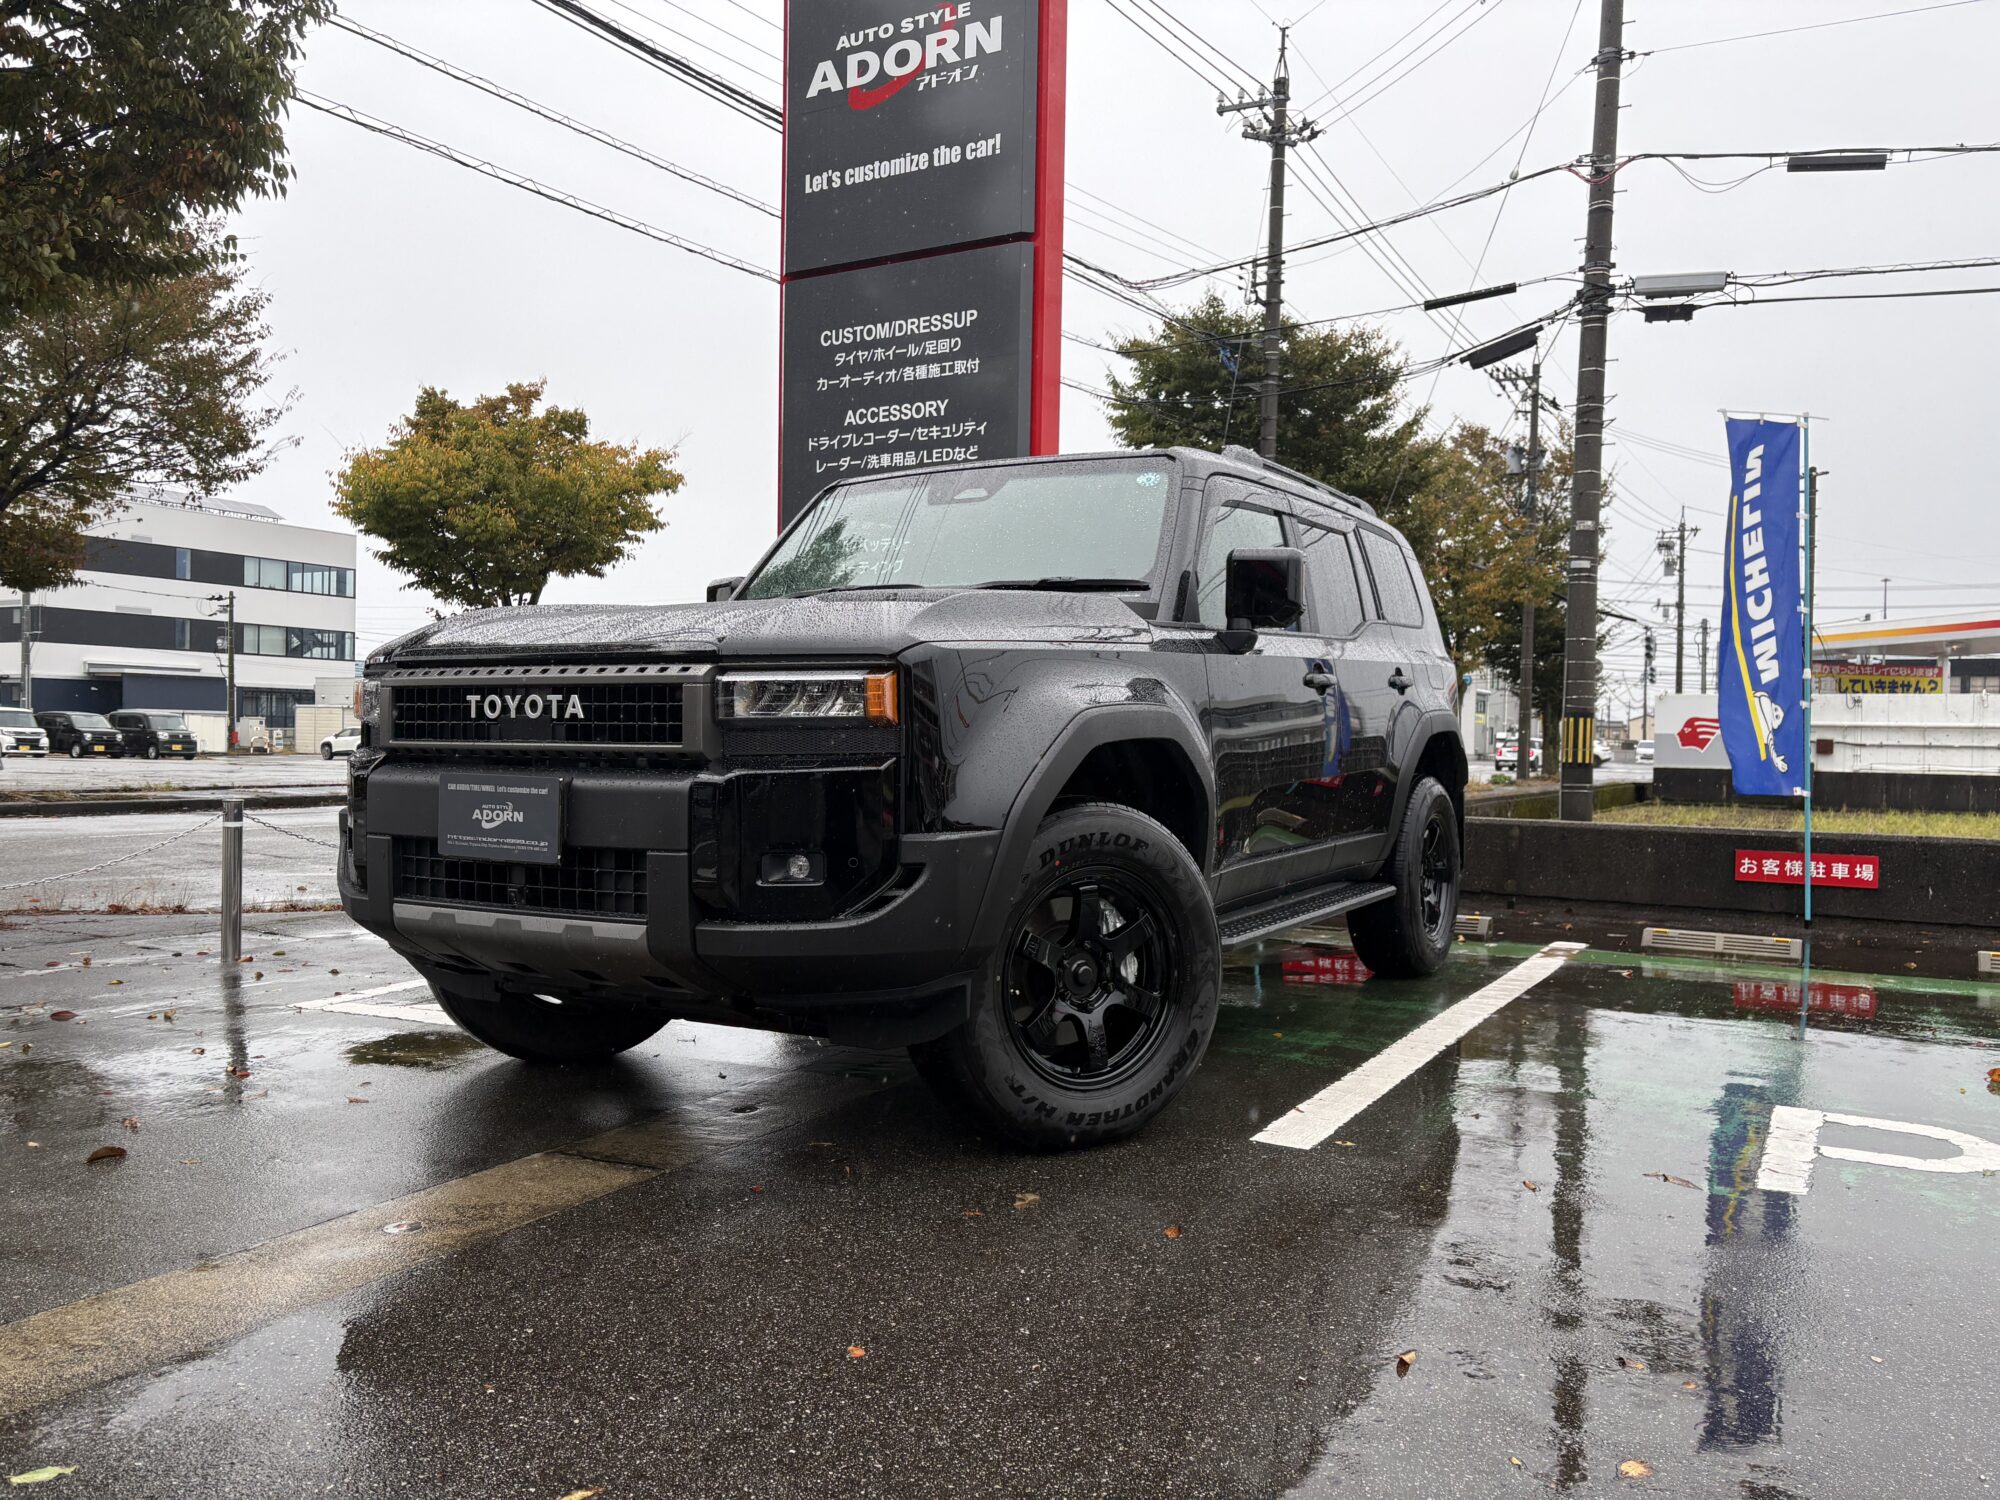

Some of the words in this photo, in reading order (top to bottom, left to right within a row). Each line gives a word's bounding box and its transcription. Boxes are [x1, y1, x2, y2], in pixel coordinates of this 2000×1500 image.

[836, 24, 893, 51] AUTO
[900, 2, 971, 34] STYLE
[806, 16, 1002, 98] ADORN
[916, 65, 979, 91] アドオン
[805, 170, 841, 194] Let's
[845, 151, 928, 186] customize
[933, 142, 961, 167] the
[966, 133, 1001, 160] car!
[820, 309, 978, 347] CUSTOM/DRESSUP
[834, 337, 961, 366] タイヤ/ホイール/足回り
[816, 358, 980, 391] カーオーディオ/各種施工取付
[844, 399, 949, 426] ACCESSORY
[808, 421, 987, 452] ドライブレコーダー/セキュリティ
[816, 445, 978, 473] レーダー/洗車用品/LEDなど
[466, 694, 585, 719] TOYOTA
[472, 809, 524, 823] ADORN
[1039, 832, 1150, 870] DUNLOP
[1739, 857, 1875, 882] お客様駐車場
